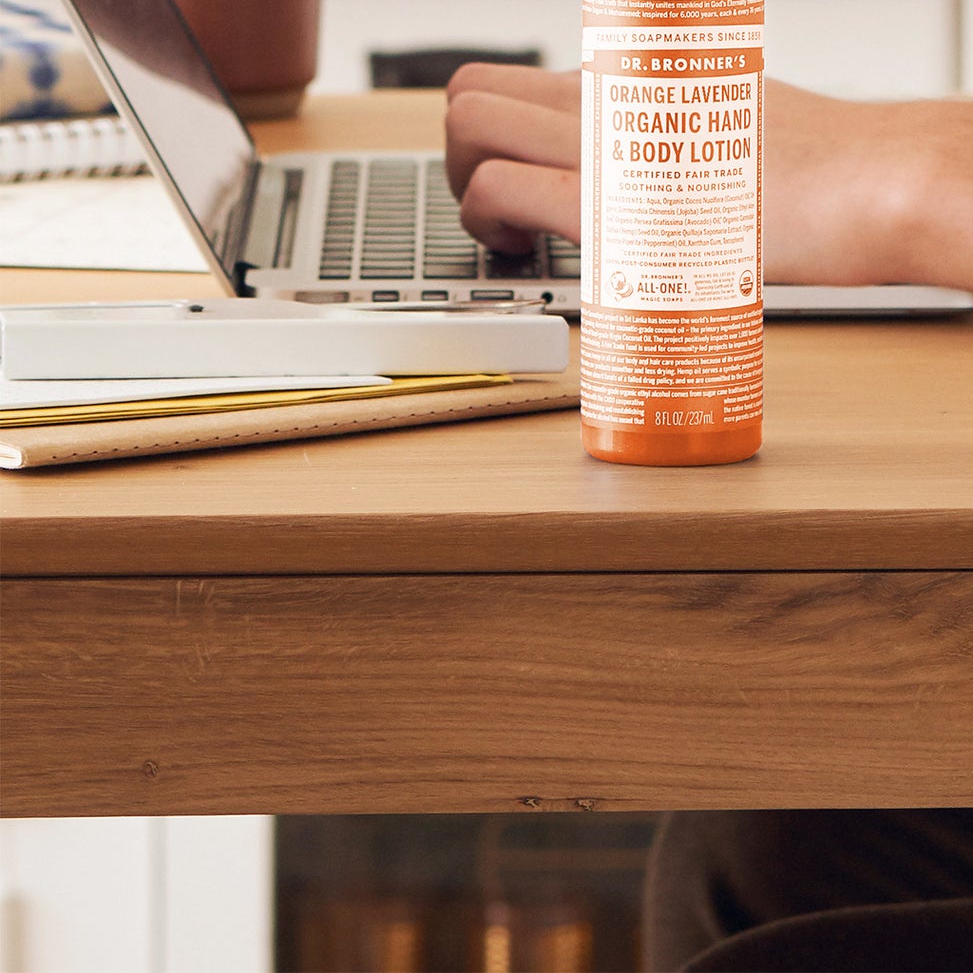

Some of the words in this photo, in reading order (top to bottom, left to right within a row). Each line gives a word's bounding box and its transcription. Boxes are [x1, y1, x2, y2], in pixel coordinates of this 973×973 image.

[642, 11, 667, 19] inspired
[596, 34, 628, 42] FAMILY
[632, 33, 713, 42] SOAPMAKERS
[718, 32, 745, 41] SINCE
[621, 57, 647, 71] DR.
[652, 55, 746, 71] BRONNER'S
[610, 84, 675, 103] ORANGE
[682, 83, 751, 103] LAVENDER
[613, 110, 701, 133] ORGANIC
[708, 108, 751, 133] HAND
[613, 140, 624, 161] &
[630, 141, 684, 163] BODY
[691, 137, 751, 162] LOTION
[623, 170, 680, 179] CERTIFIED
[714, 167, 743, 178] TRADE
[619, 183, 672, 192] SOOTHING
[688, 180, 746, 191] NOURISHING
[675, 358, 699, 366] products
[656, 411, 660, 425] 8
[662, 412, 671, 425] FL
